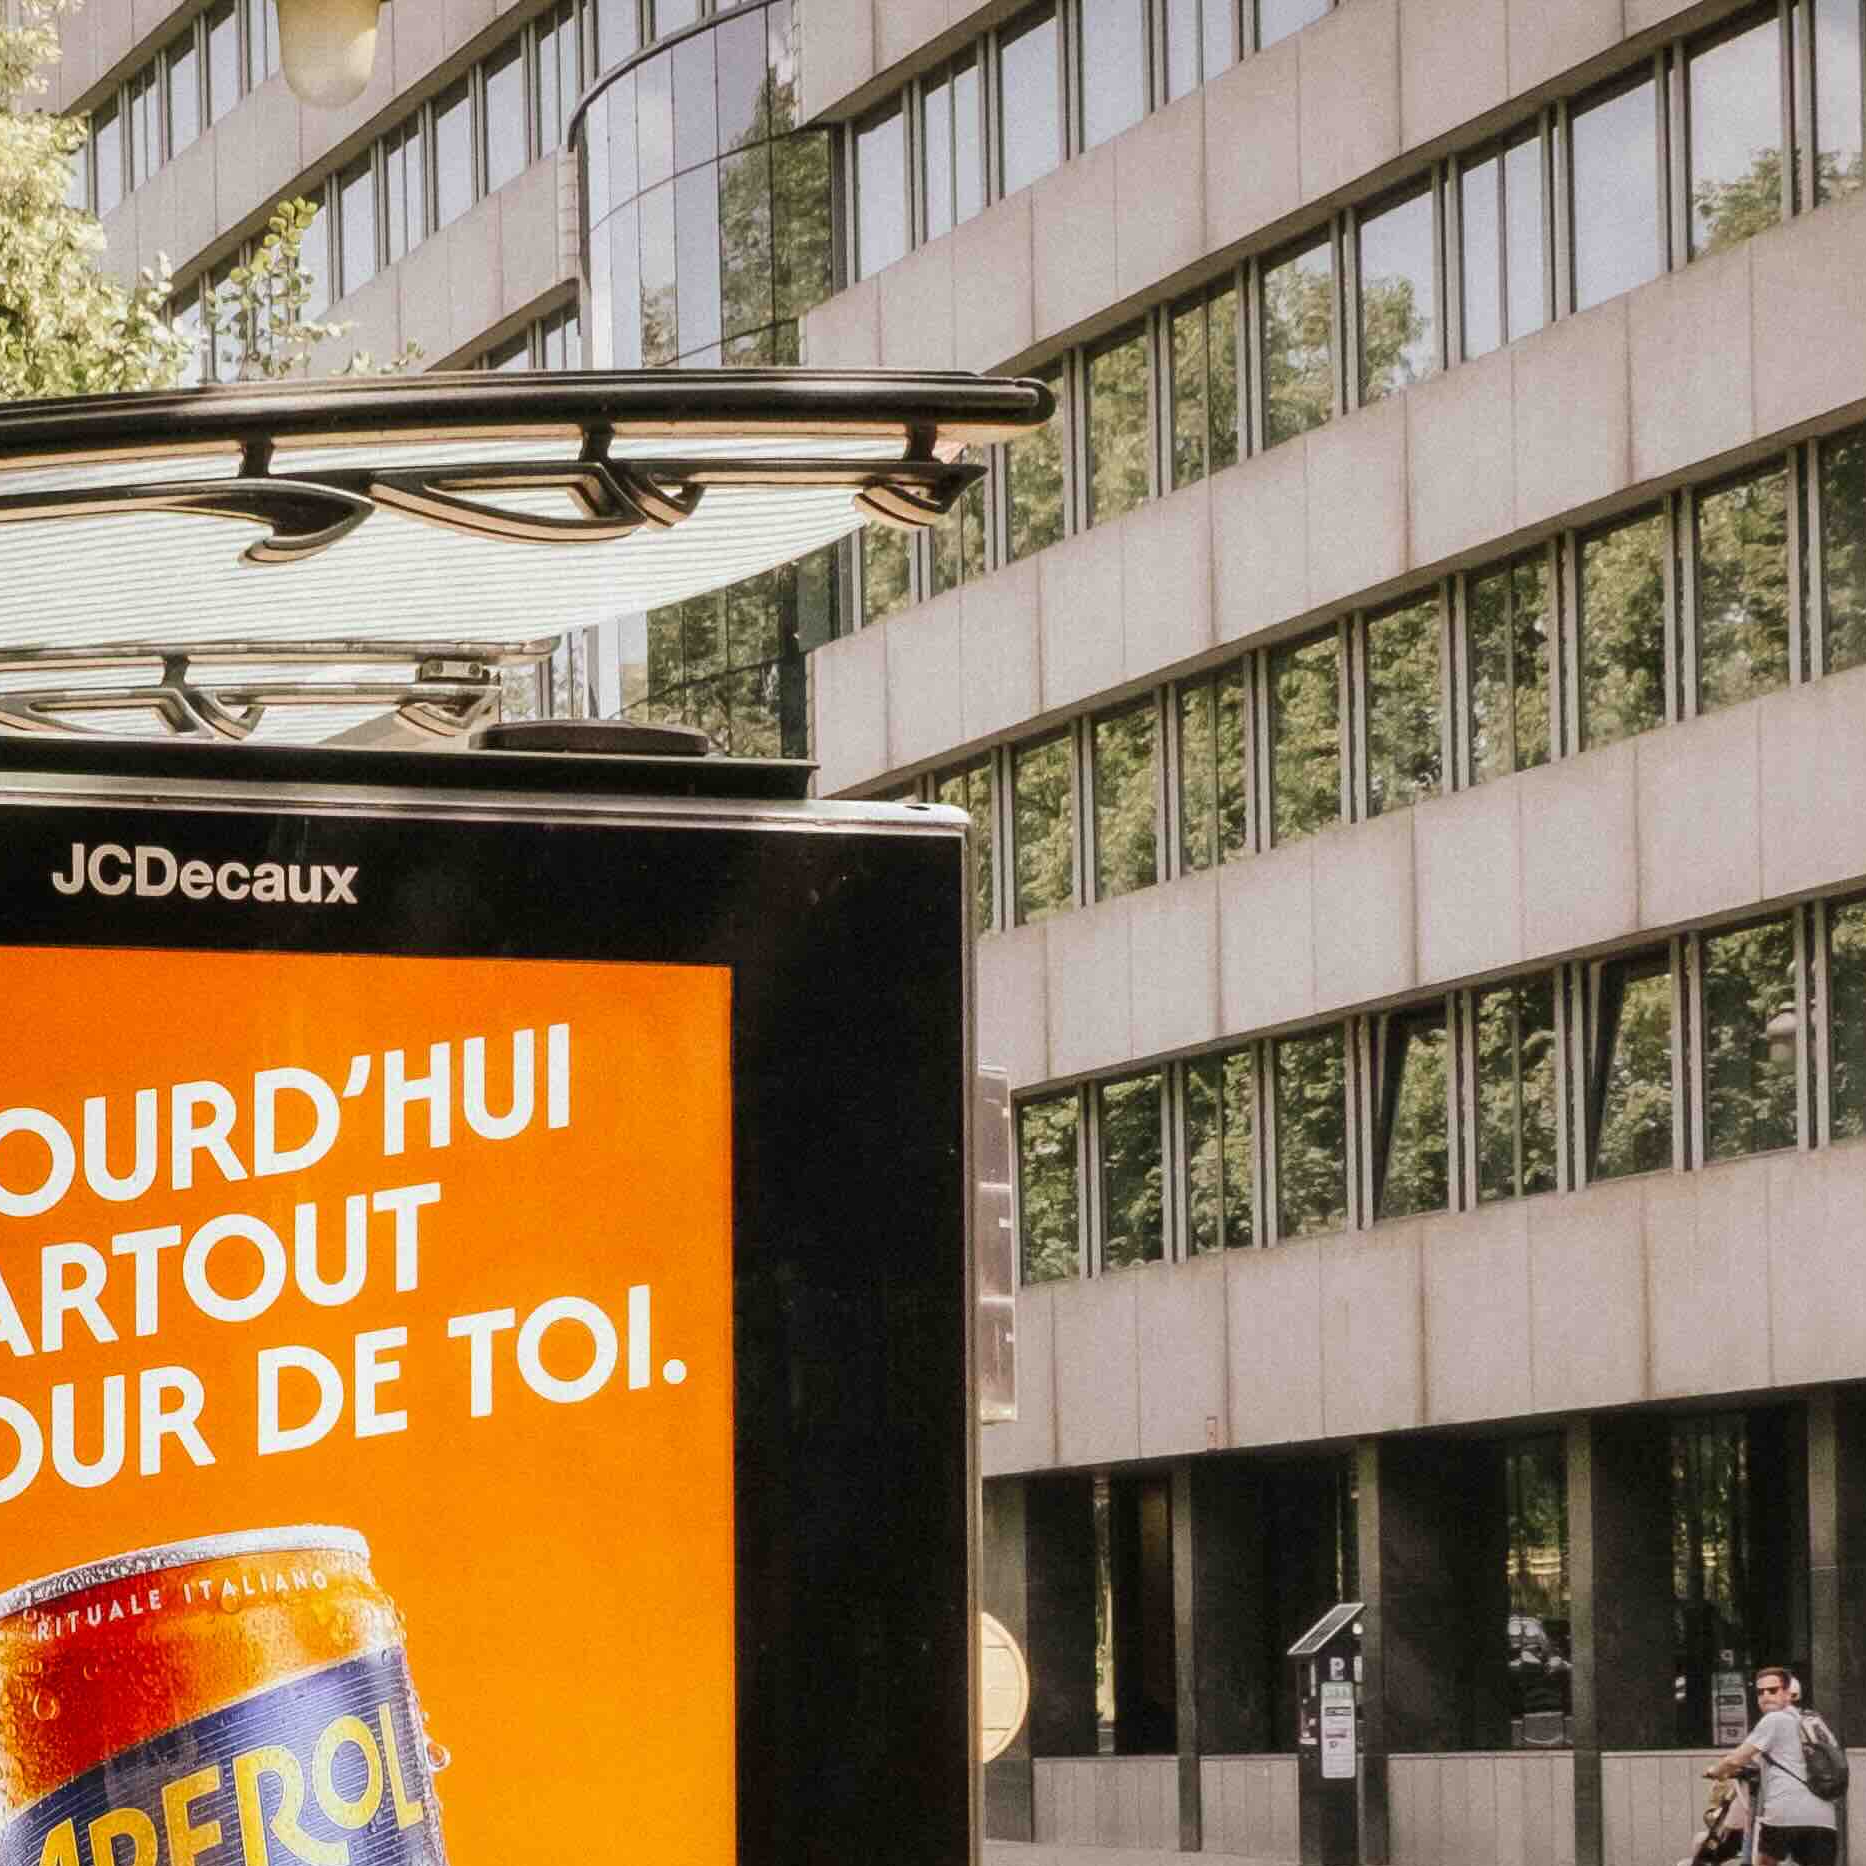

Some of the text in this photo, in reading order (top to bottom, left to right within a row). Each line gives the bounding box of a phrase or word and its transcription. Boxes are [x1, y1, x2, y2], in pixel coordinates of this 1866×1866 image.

[52, 842, 359, 904] JCDecaux
[257, 1326, 408, 1456] DE
[447, 1284, 688, 1417] TOI.
[36, 1569, 329, 1642] RITUALE ITALIANO
